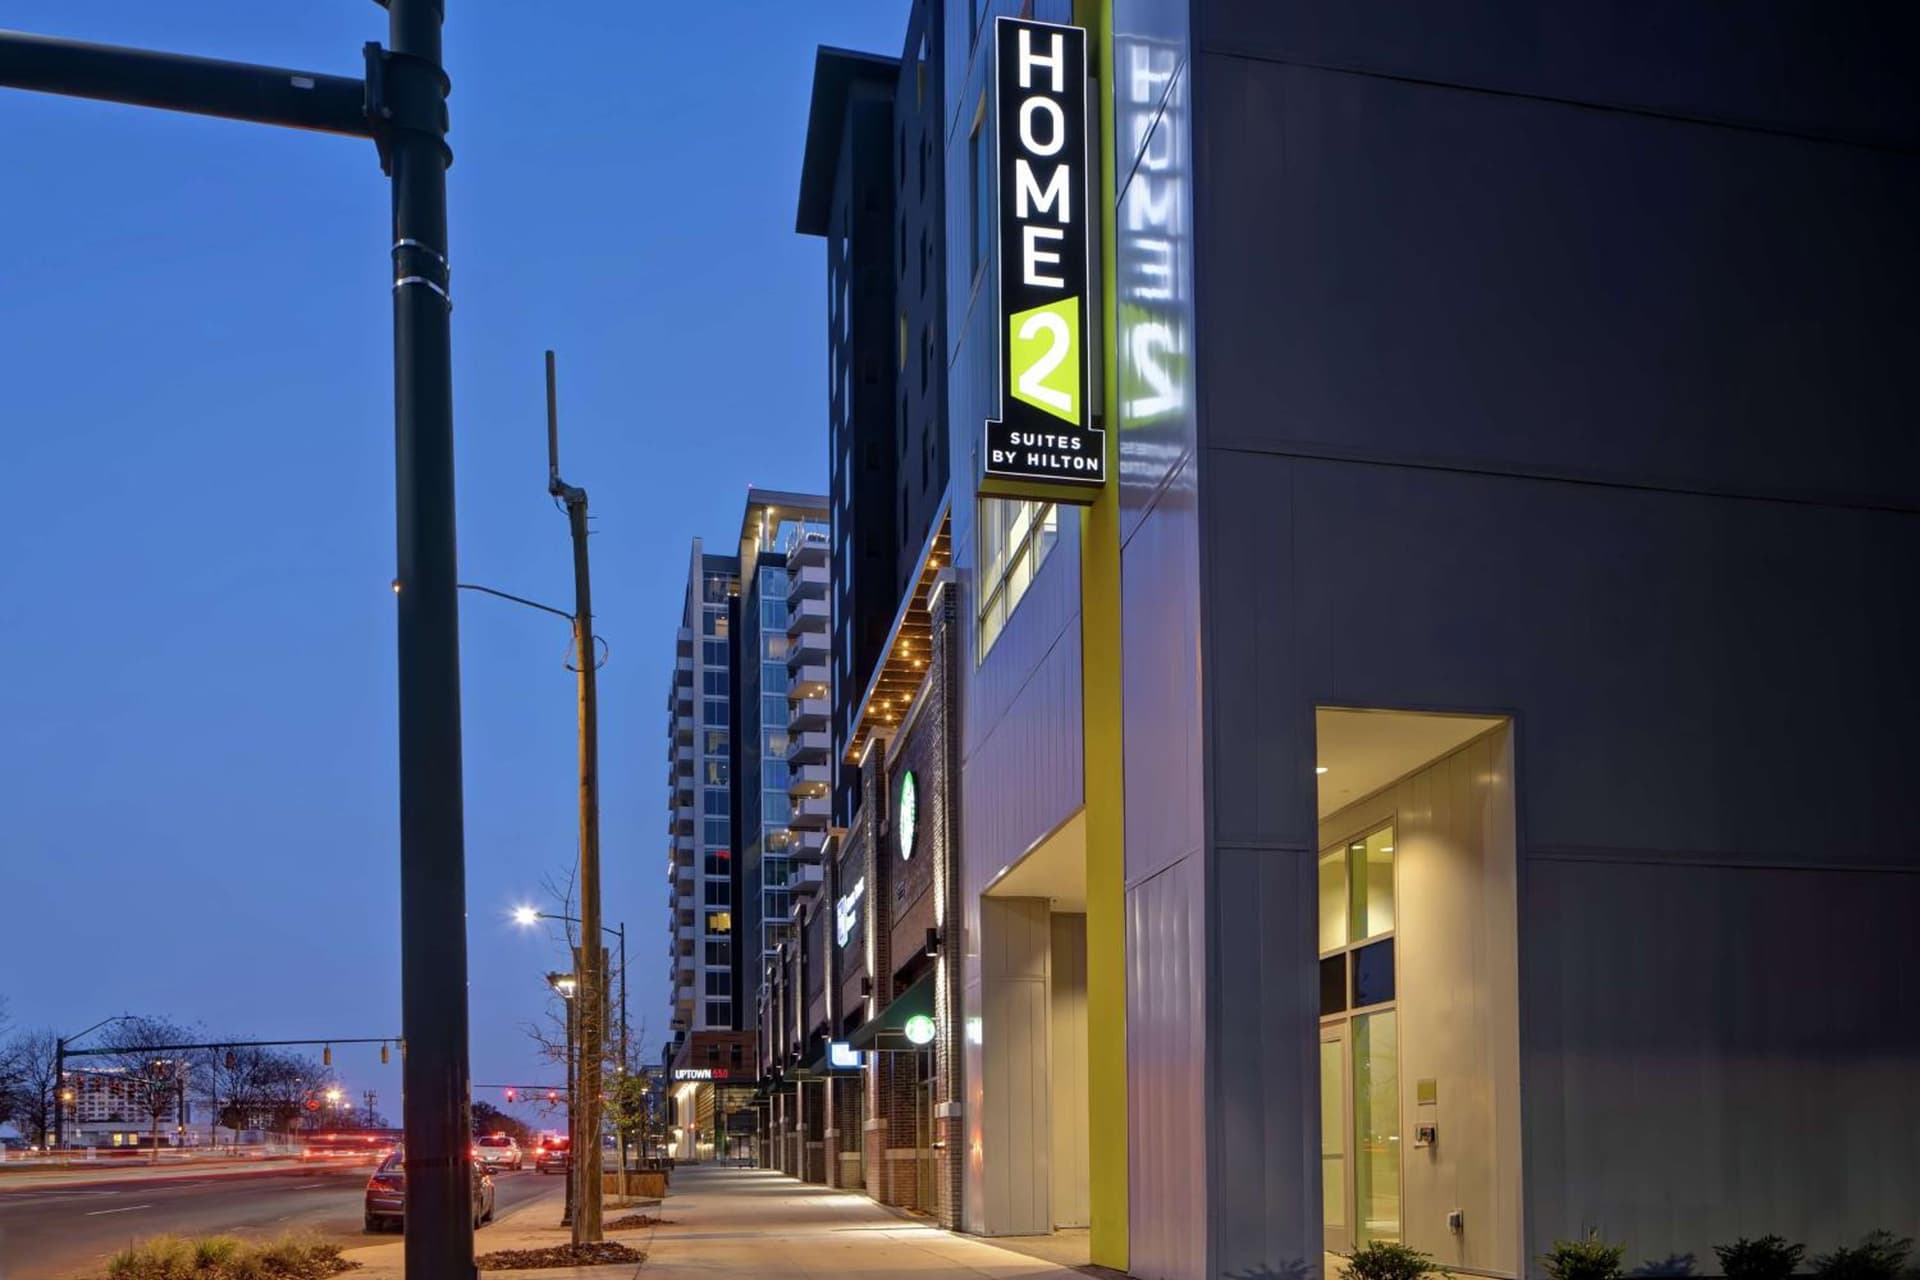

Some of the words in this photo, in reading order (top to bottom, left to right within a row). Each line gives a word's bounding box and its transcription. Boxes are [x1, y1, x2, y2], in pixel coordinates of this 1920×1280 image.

[1016, 29, 1071, 289] HOME
[1018, 312, 1072, 412] 2
[1010, 432, 1081, 449] SUITES
[992, 450, 1016, 463] BY
[1027, 453, 1098, 471] HILTON
[675, 1069, 711, 1079] UPTOWN
